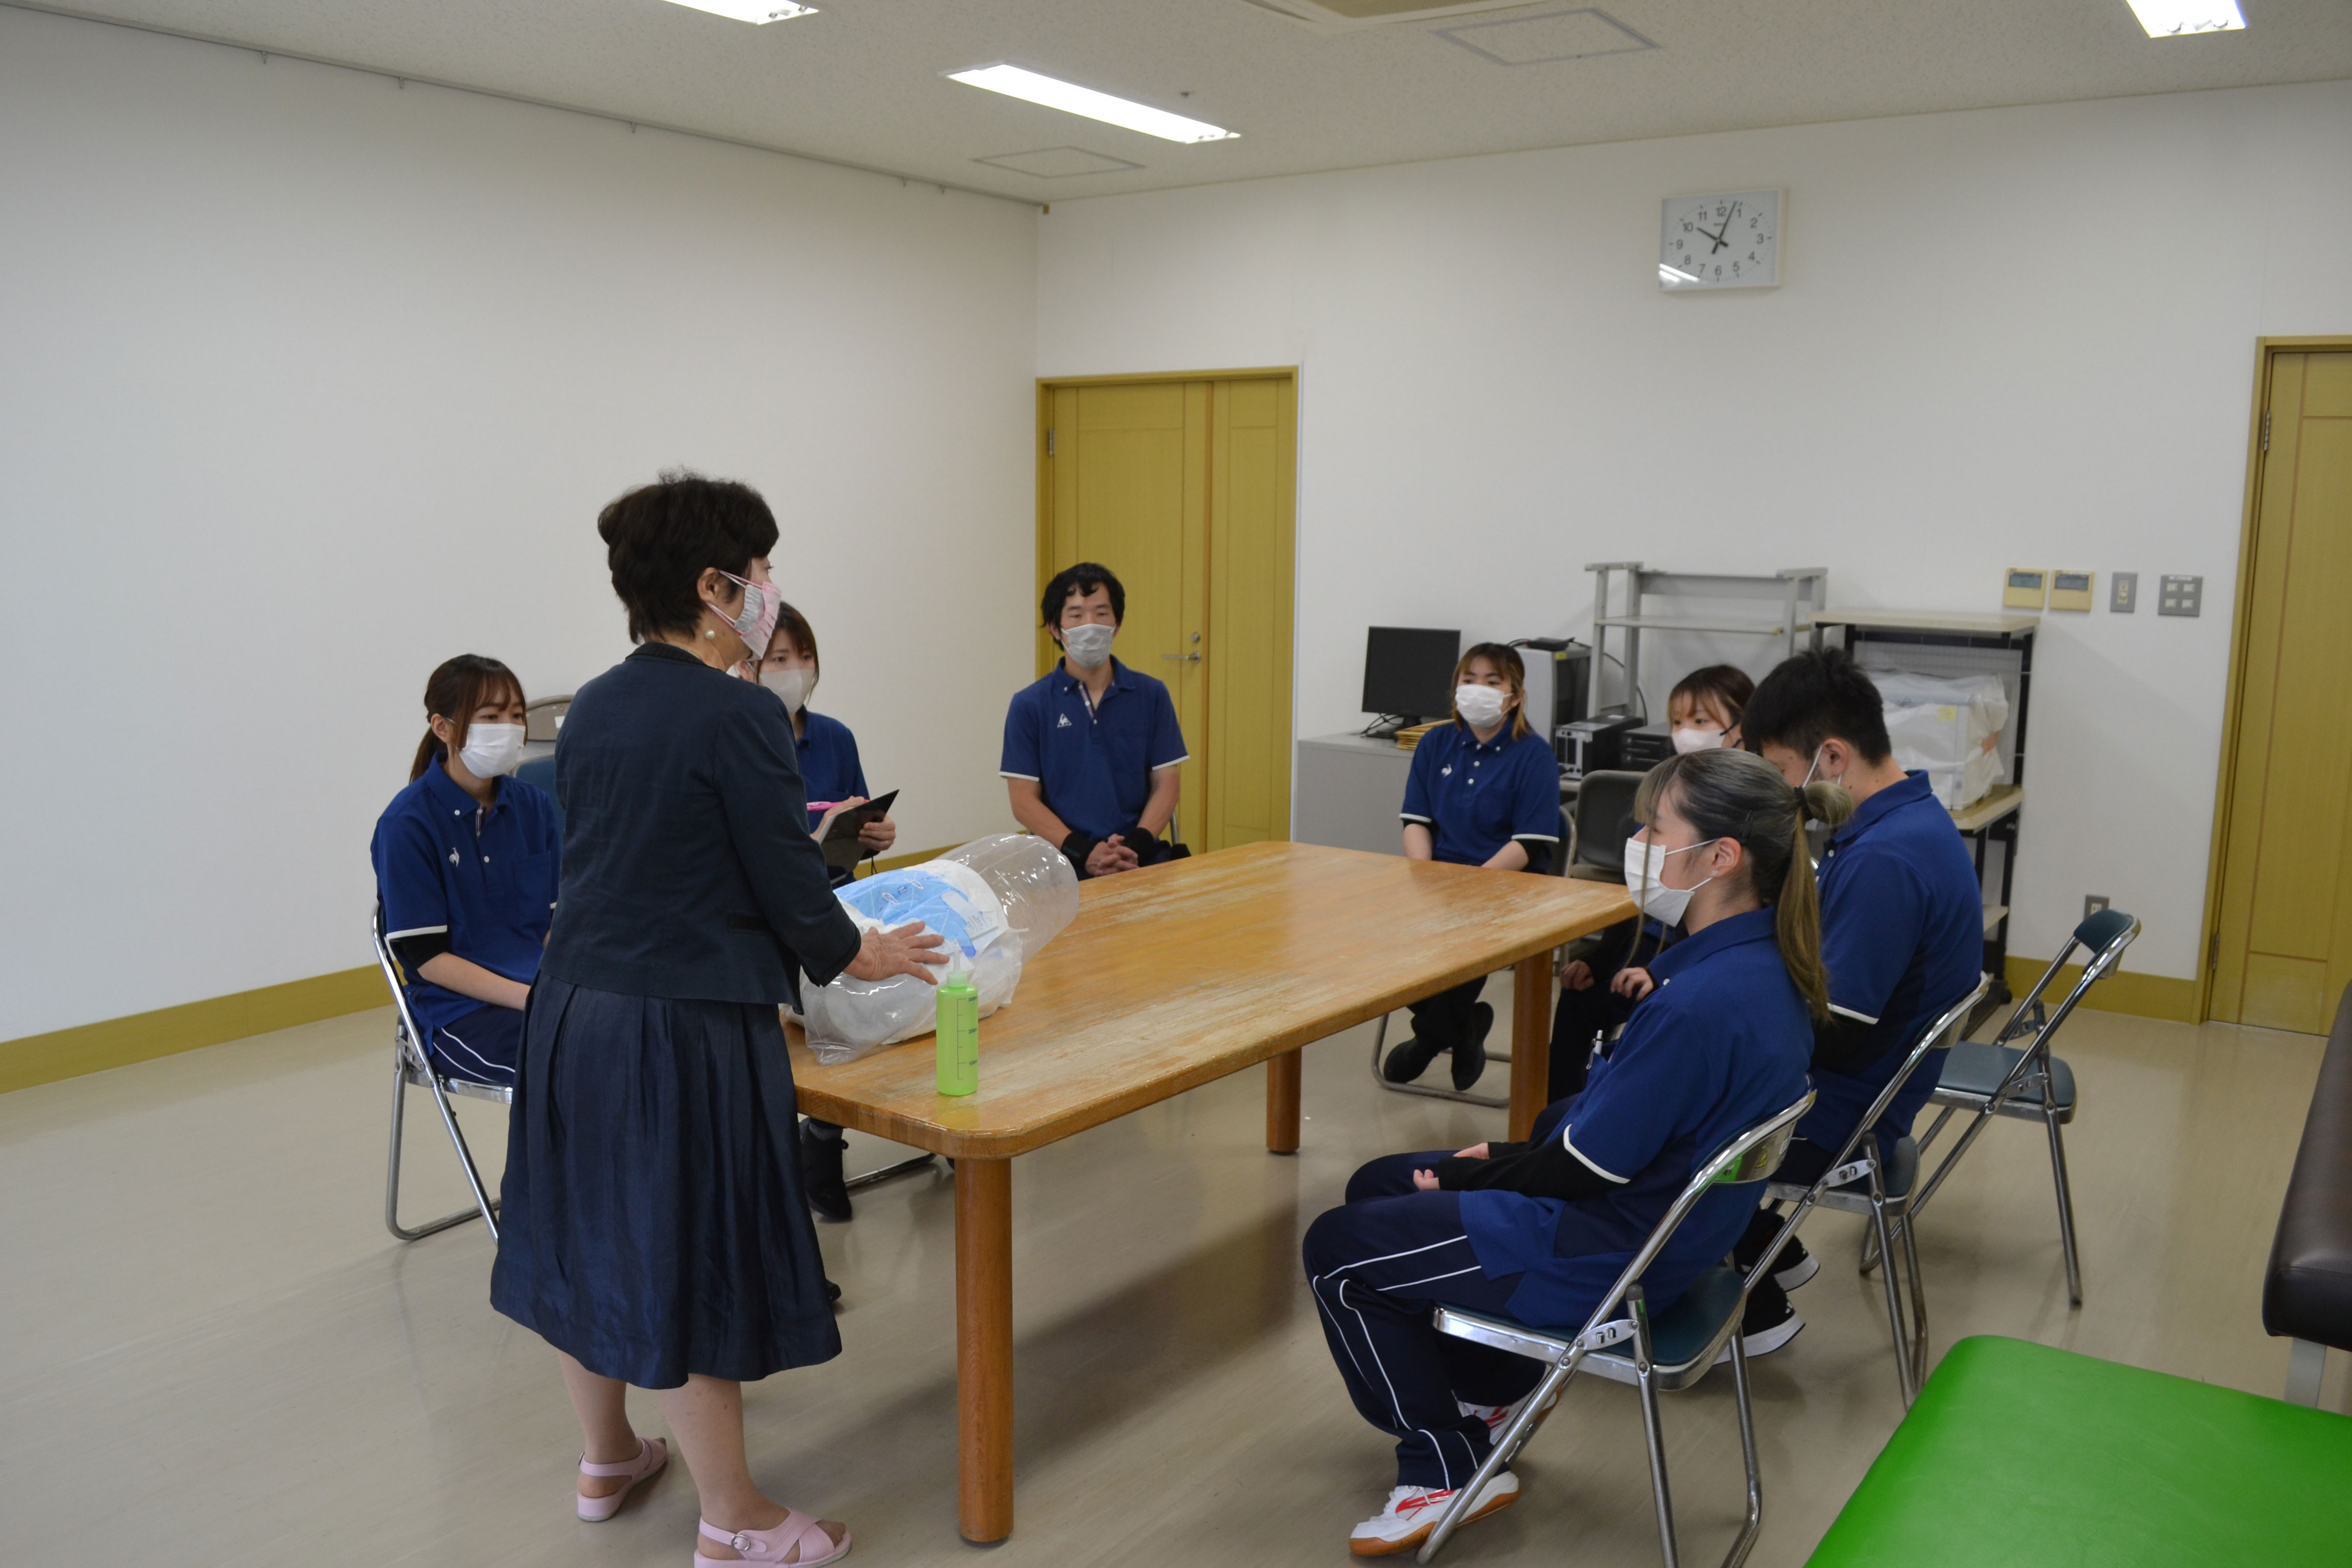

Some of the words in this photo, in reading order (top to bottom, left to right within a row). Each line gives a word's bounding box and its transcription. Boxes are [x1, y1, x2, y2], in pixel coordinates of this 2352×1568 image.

[1698, 211, 1707, 220] 11
[1716, 206, 1727, 216] 12
[1737, 208, 1742, 218] 1
[1683, 222, 1693, 232] 10
[1750, 217, 1757, 228] 2
[1757, 233, 1764, 244] 3
[1676, 239, 1683, 250] 9
[1684, 255, 1691, 264] 8
[1749, 251, 1755, 261] 4
[1699, 263, 1706, 273] 7
[1715, 265, 1722, 276] 6
[1733, 261, 1739, 272] 5
